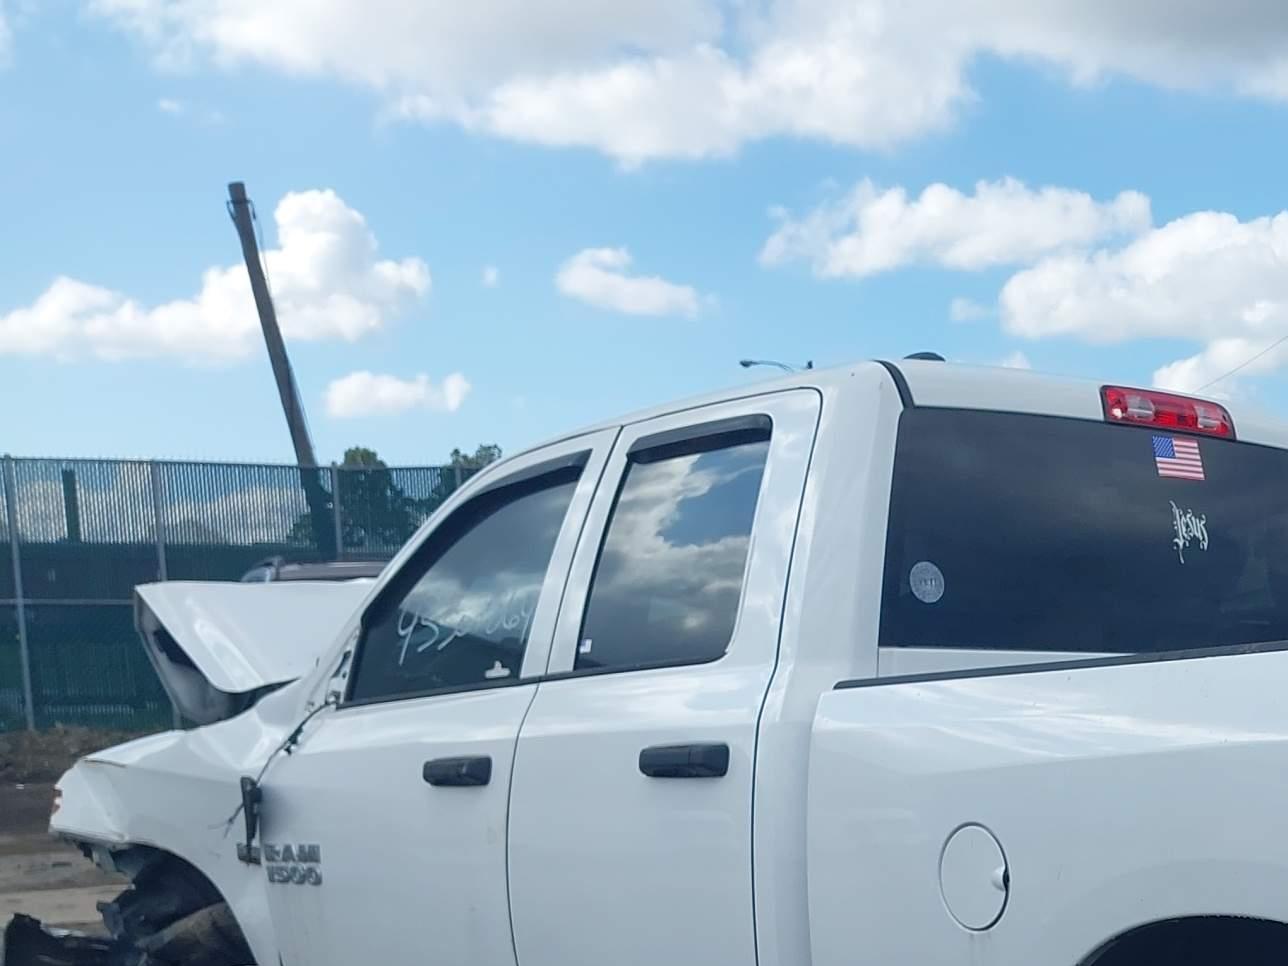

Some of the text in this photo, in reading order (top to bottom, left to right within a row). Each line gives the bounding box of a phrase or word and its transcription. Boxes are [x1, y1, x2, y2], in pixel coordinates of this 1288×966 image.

[1168, 499, 1209, 565] Jesus
[263, 843, 321, 862] RAM
[266, 865, 323, 886] 1500
